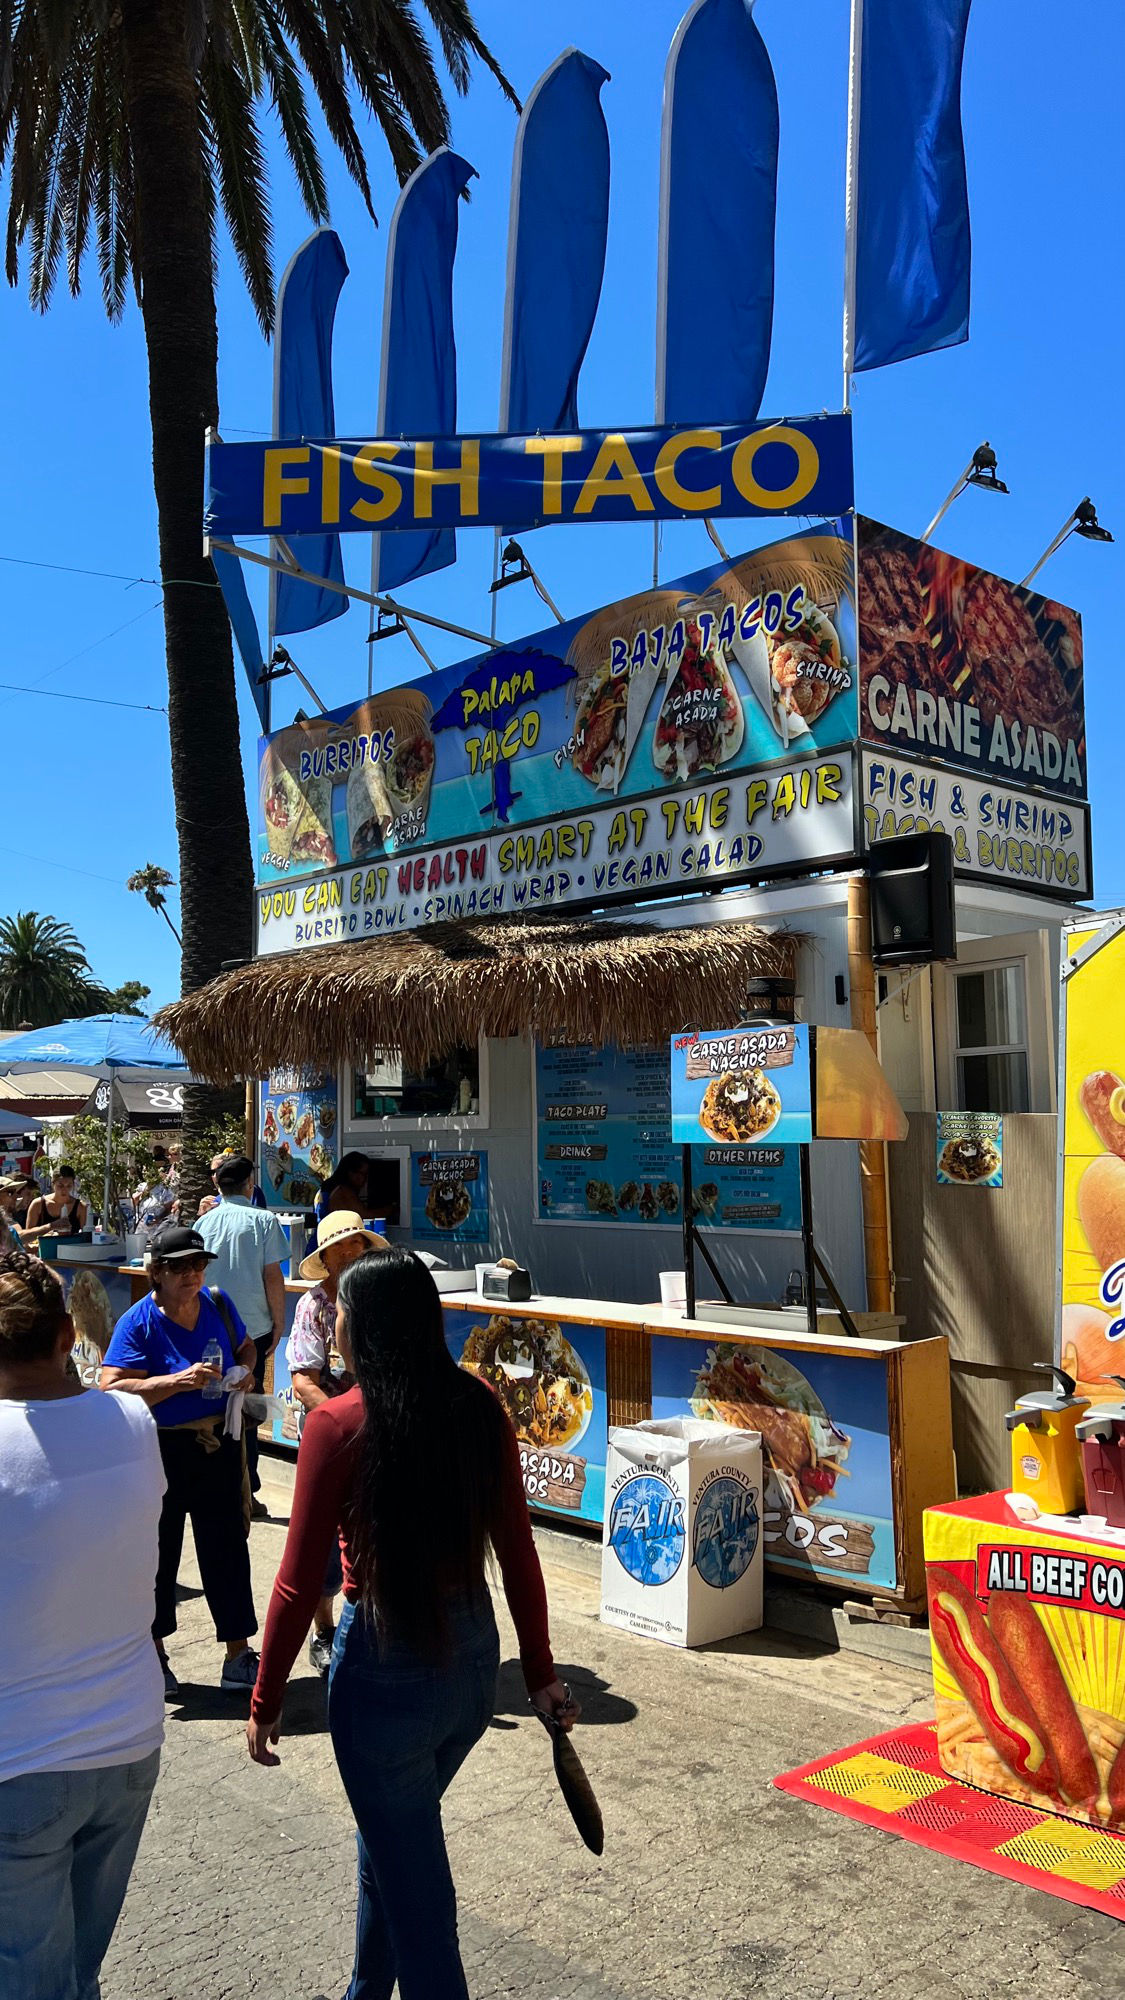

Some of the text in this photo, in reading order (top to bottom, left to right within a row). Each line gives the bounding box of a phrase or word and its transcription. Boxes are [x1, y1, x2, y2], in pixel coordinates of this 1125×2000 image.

[263, 426, 819, 527] FISH TACO
[611, 585, 805, 676] BAJA TACOS
[796, 660, 852, 690] SHRIMP
[461, 670, 535, 723] Palapa
[672, 688, 723, 711] CARNE
[675, 705, 718, 728] ASADA
[868, 674, 1083, 787] CARNE ASADA
[301, 728, 395, 780] BURRITOS
[465, 711, 540, 775] TACO
[554, 728, 586, 769] FISH
[869, 763, 1074, 843] FISH & SHRIMP
[386, 805, 424, 837] CARNE
[393, 822, 426, 850] ASADA
[260, 763, 842, 925] YOU CAN EAT HEALTH SMART AT THE FAIR
[954, 826, 972, 863] &
[977, 830, 1080, 886] BURRITOS
[261, 852, 290, 872] VEGGIE
[295, 833, 763, 943] BURRITO BOWL SPINACH WRAP VEGAN SALAD
[674, 1032, 699, 1050] NEW!
[690, 1039, 736, 1060] CARNE
[740, 1032, 787, 1054] ASADA
[710, 1051, 767, 1073] NACHOS
[547, 1104, 607, 1118] TACO PLATE
[943, 1131, 998, 1139] NACHOS
[422, 1158, 475, 1172] CARNE ASADA
[560, 1146, 592, 1158] DRINKS
[709, 1150, 781, 1163] OTHER ITEMS
[432, 1170, 464, 1181] NACHOS
[520, 1450, 575, 1485] ASADA
[611, 1464, 681, 1493] VENTURA COUNTY
[692, 1466, 752, 1506] VENTURA COUNTY
[606, 1497, 687, 1546] FAIR
[691, 1487, 760, 1567] FAIR
[987, 1551, 1125, 1608] ALL BEEF CO
[604, 1605, 629, 1617] COURTESY
[629, 1620, 658, 1633] CAMARILLO
